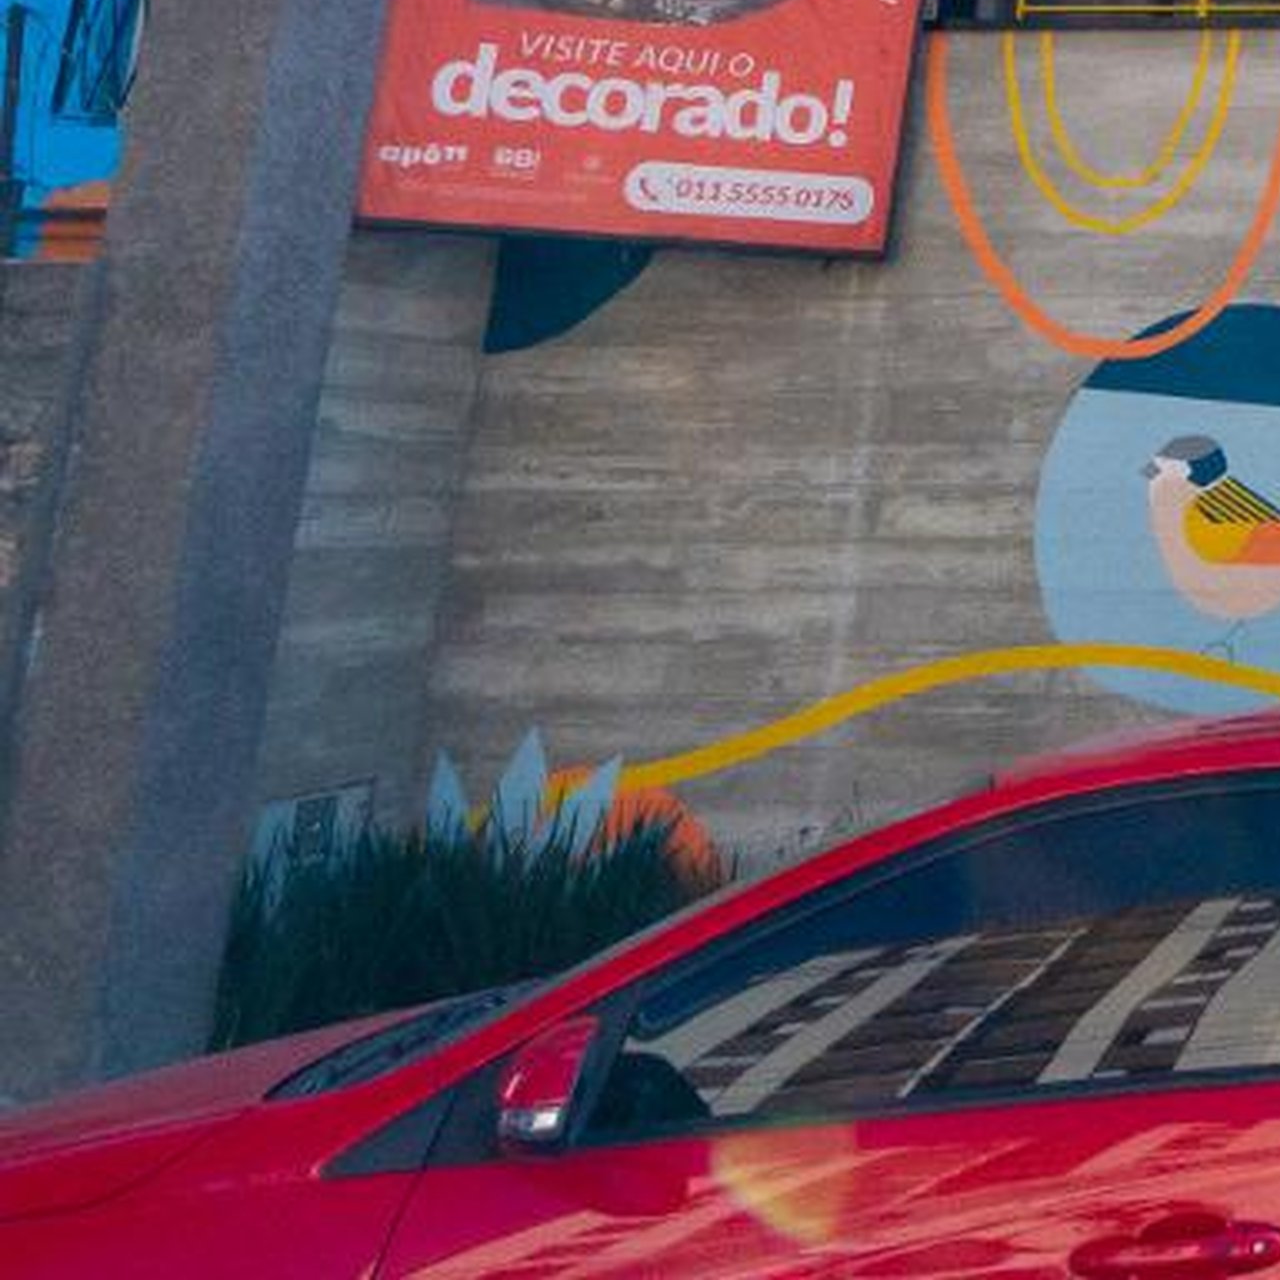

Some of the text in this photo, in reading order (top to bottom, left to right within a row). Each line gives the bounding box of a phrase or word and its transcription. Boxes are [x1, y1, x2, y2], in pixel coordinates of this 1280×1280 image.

[519, 31, 756, 78] VISITE AQUI O
[431, 42, 854, 148] decorado!
